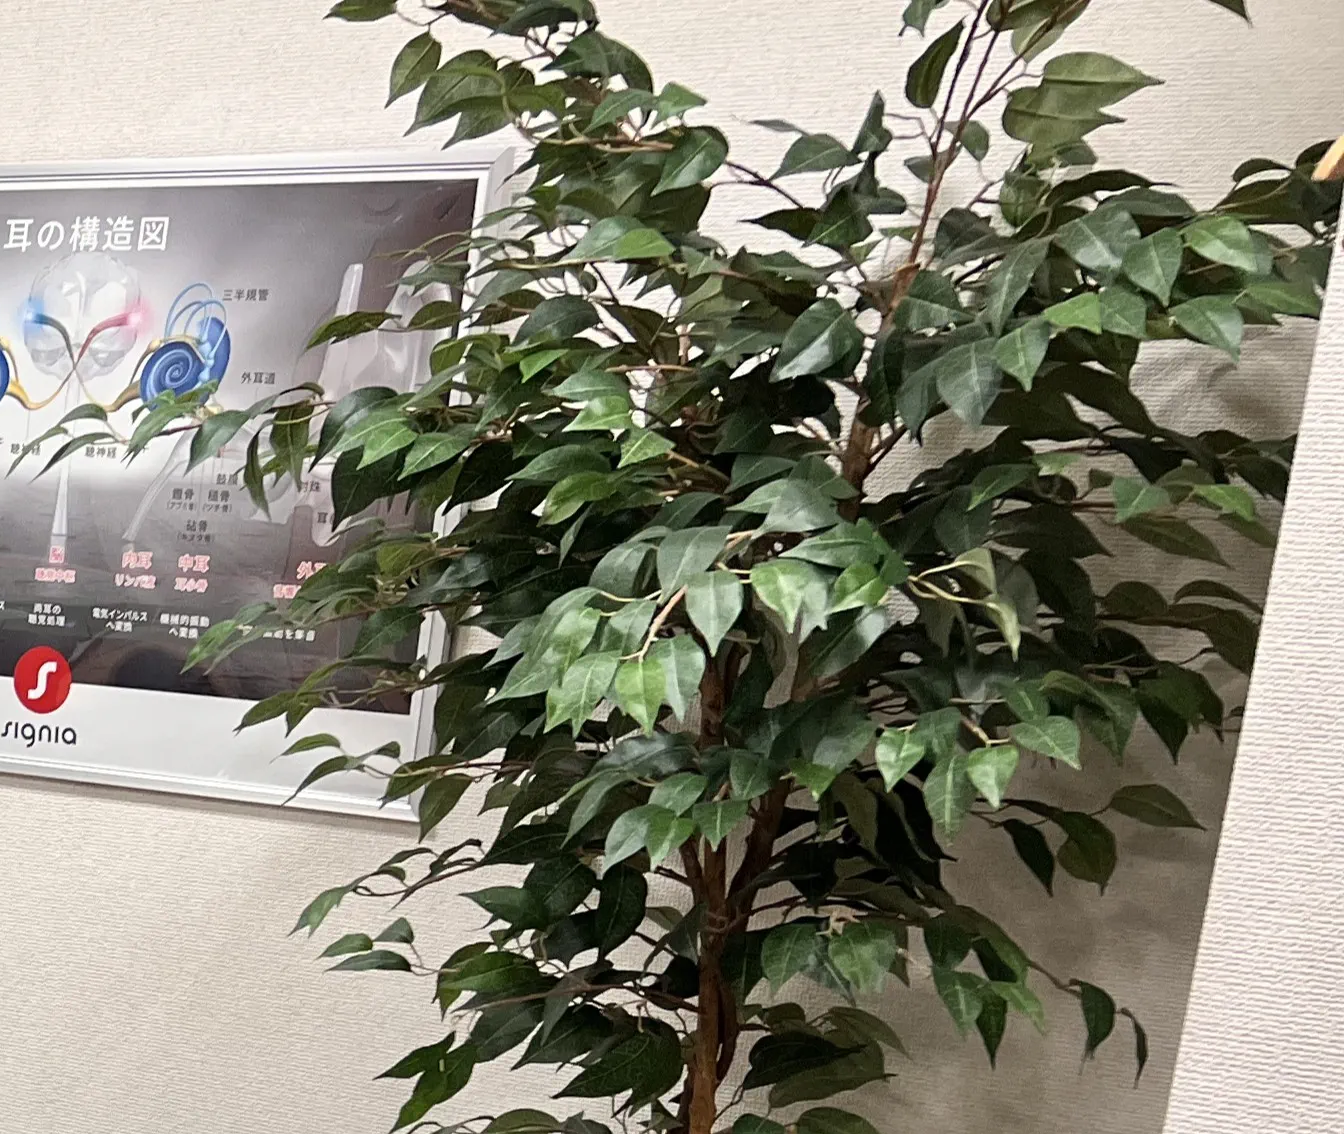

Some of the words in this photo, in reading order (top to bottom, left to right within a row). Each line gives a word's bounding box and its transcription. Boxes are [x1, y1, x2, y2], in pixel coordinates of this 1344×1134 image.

[3, 215, 170, 252] 耳の構造図
[222, 289, 270, 301] 三半規管
[241, 371, 276, 385] 外耳道
[121, 551, 153, 570] 内耳
[177, 553, 210, 574] 中耳
[92, 607, 148, 622] 電気インパルス
[160, 612, 210, 628] 機械的振動
[105, 621, 133, 633] へ変換
[168, 627, 199, 640] へ変換
[1, 721, 77, 748] signia
